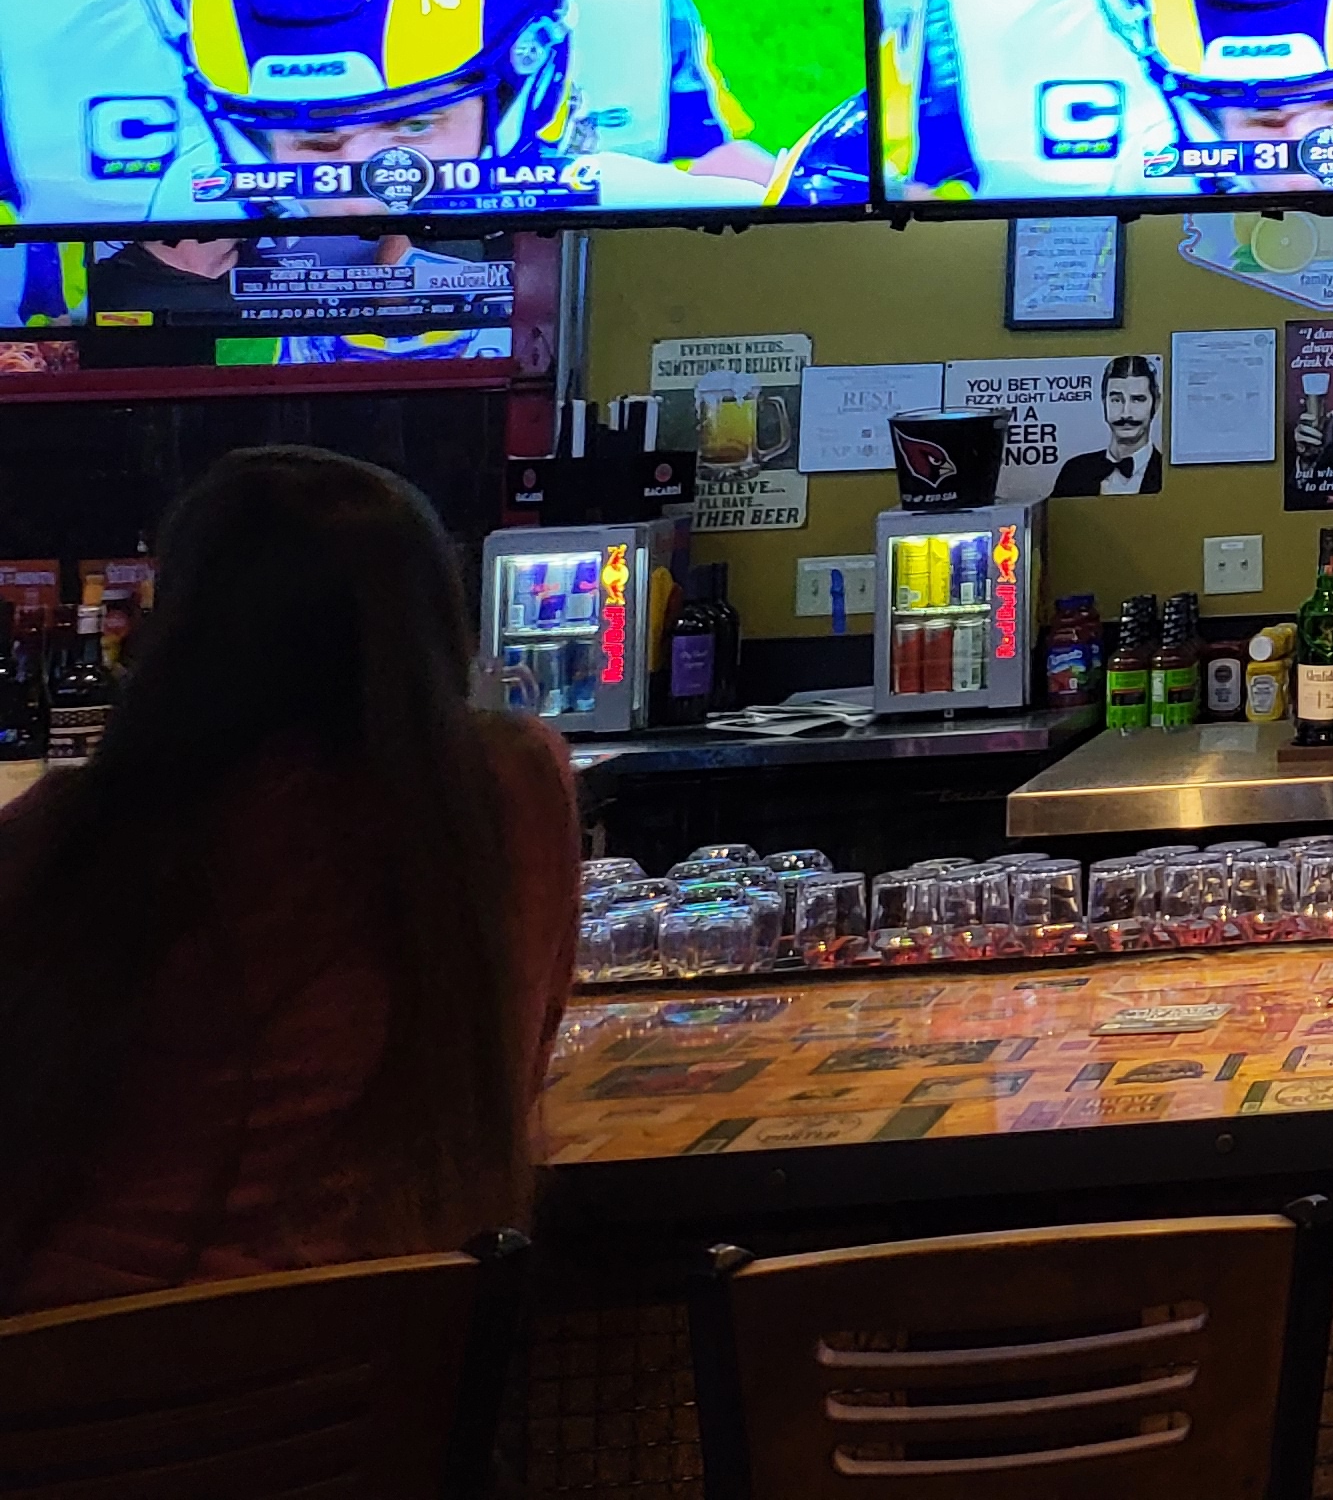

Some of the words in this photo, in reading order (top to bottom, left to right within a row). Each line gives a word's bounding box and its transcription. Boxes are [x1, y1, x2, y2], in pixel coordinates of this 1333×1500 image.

[269, 62, 346, 77] RAMS
[1183, 149, 1237, 167] BUF
[1254, 143, 1288, 169] 31
[235, 172, 295, 189] BUF
[314, 165, 352, 191] 31
[374, 169, 421, 183] 2:00
[440, 163, 480, 190] 10
[497, 165, 555, 182] LAR
[500, 197, 514, 208] &
[517, 196, 537, 207] 10
[1301, 274, 1332, 287] family
[680, 342, 742, 357] EVERYONE
[658, 358, 725, 376] SOMETHING
[728, 358, 743, 374] TO
[745, 356, 792, 374] BELIEVE
[1291, 356, 1322, 369] drink
[968, 379, 1002, 392] YOU
[1007, 377, 1041, 391] BET
[1045, 376, 1092, 390] YOUR
[966, 394, 1004, 405] FIZZY
[1007, 393, 1046, 404] LIGHT
[1050, 392, 1092, 402] LAGER
[1023, 406, 1038, 421] A
[1006, 424, 1057, 444] EER
[1004, 446, 1059, 466] NOB
[1305, 480, 1316, 492] to
[693, 510, 747, 528] THER
[751, 507, 799, 525] BEER
